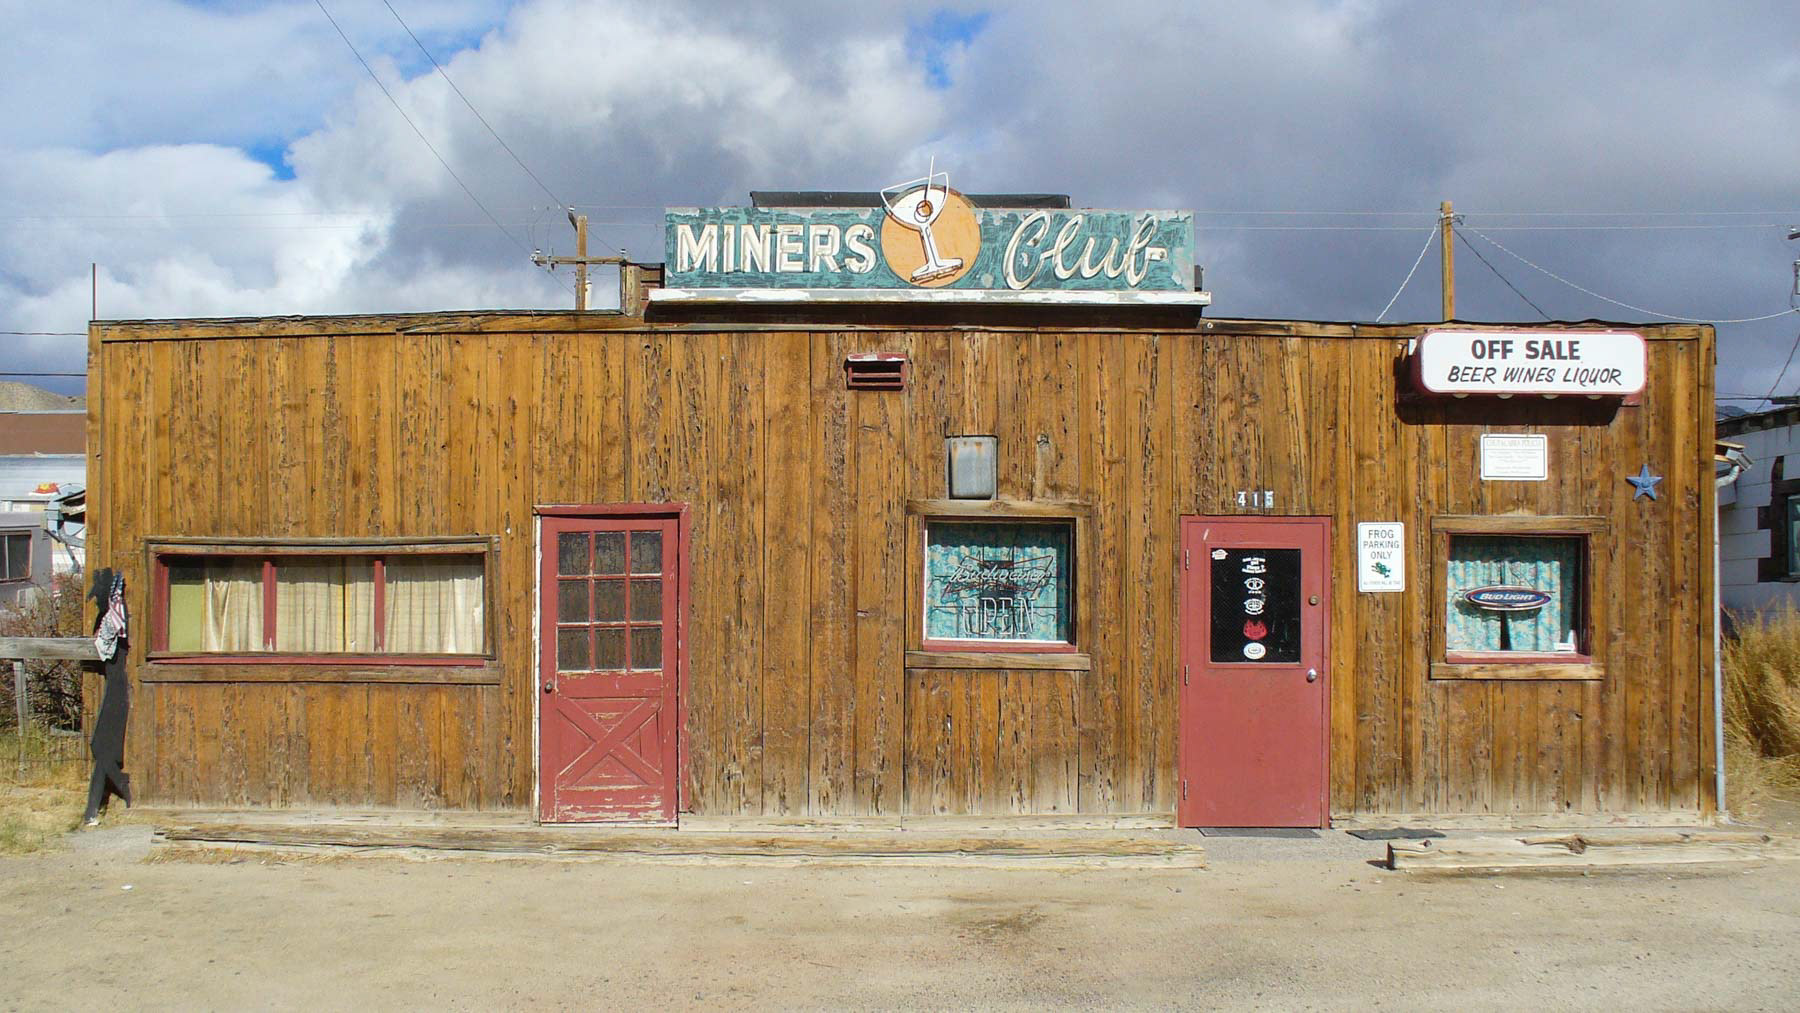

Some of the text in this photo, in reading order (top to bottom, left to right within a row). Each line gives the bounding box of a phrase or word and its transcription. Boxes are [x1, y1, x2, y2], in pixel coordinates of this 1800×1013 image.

[676, 210, 1167, 290] MINERS Club
[1471, 339, 1580, 360] OFF SALE
[1447, 365, 1622, 387] BEER WINES LIQUOR
[1237, 490, 1274, 508] 415
[1368, 529, 1394, 539] FROG
[1363, 540, 1400, 549] PARKING
[1370, 551, 1392, 560] ONLY
[1479, 592, 1536, 601] BUD LIGHT
[962, 596, 1035, 635] OPEN
